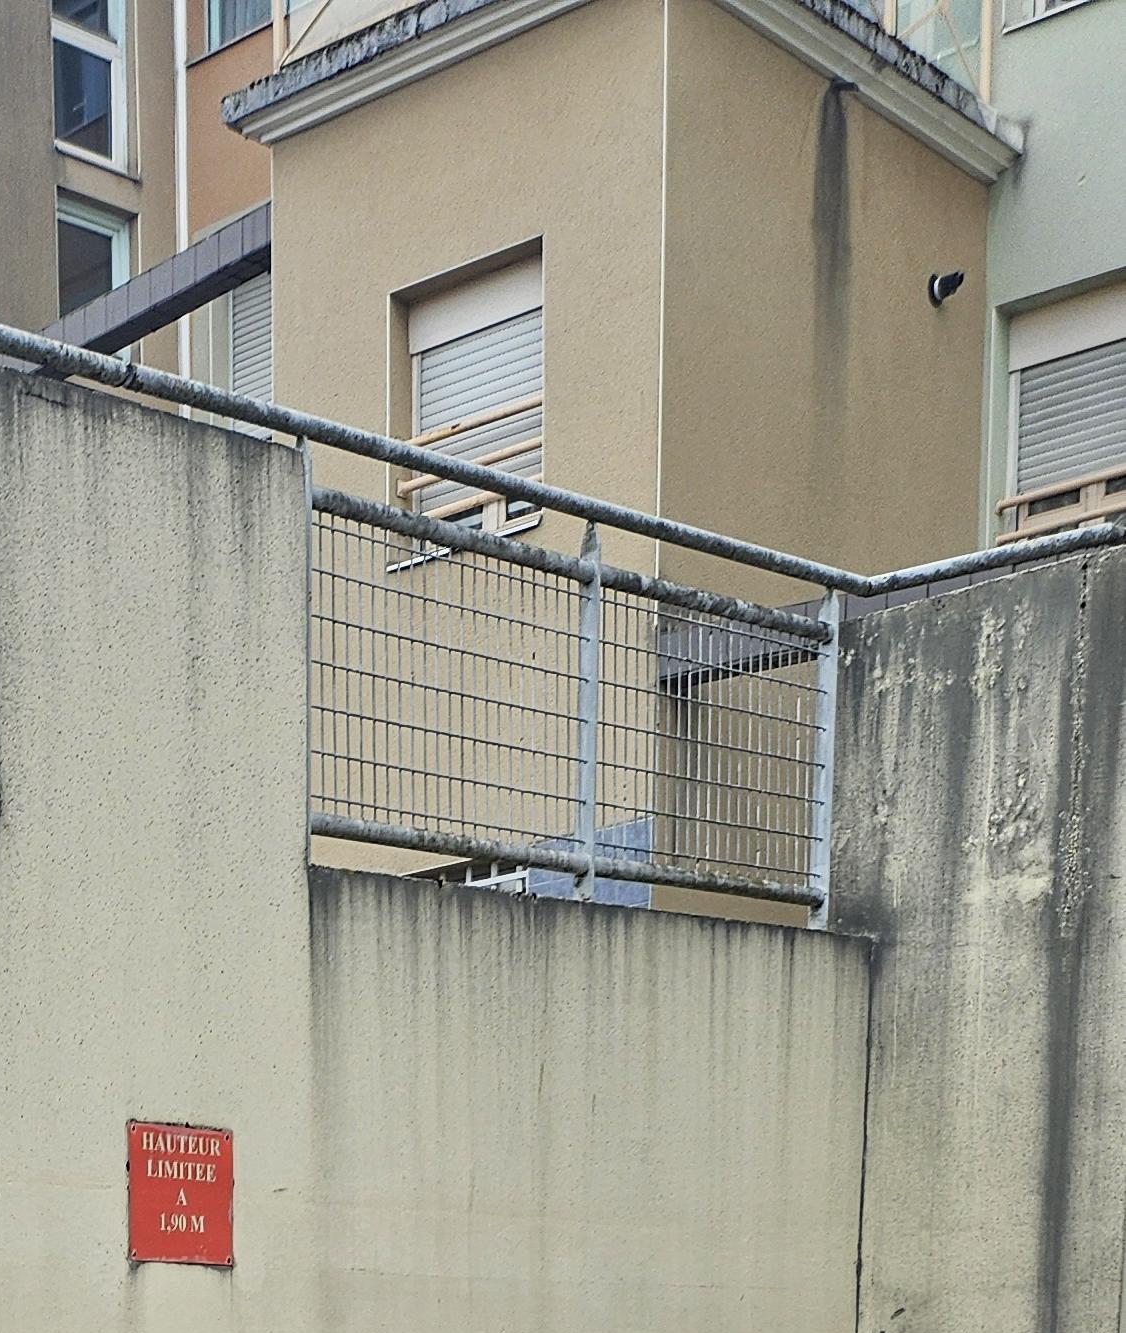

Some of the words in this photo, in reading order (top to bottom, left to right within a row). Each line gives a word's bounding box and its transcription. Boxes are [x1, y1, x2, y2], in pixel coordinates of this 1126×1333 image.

[142, 1132, 221, 1157] HAUTEUR
[147, 1159, 217, 1182] LIMITEE
[176, 1188, 187, 1206] A
[160, 1213, 187, 1235] 1,90
[190, 1215, 205, 1233] M
